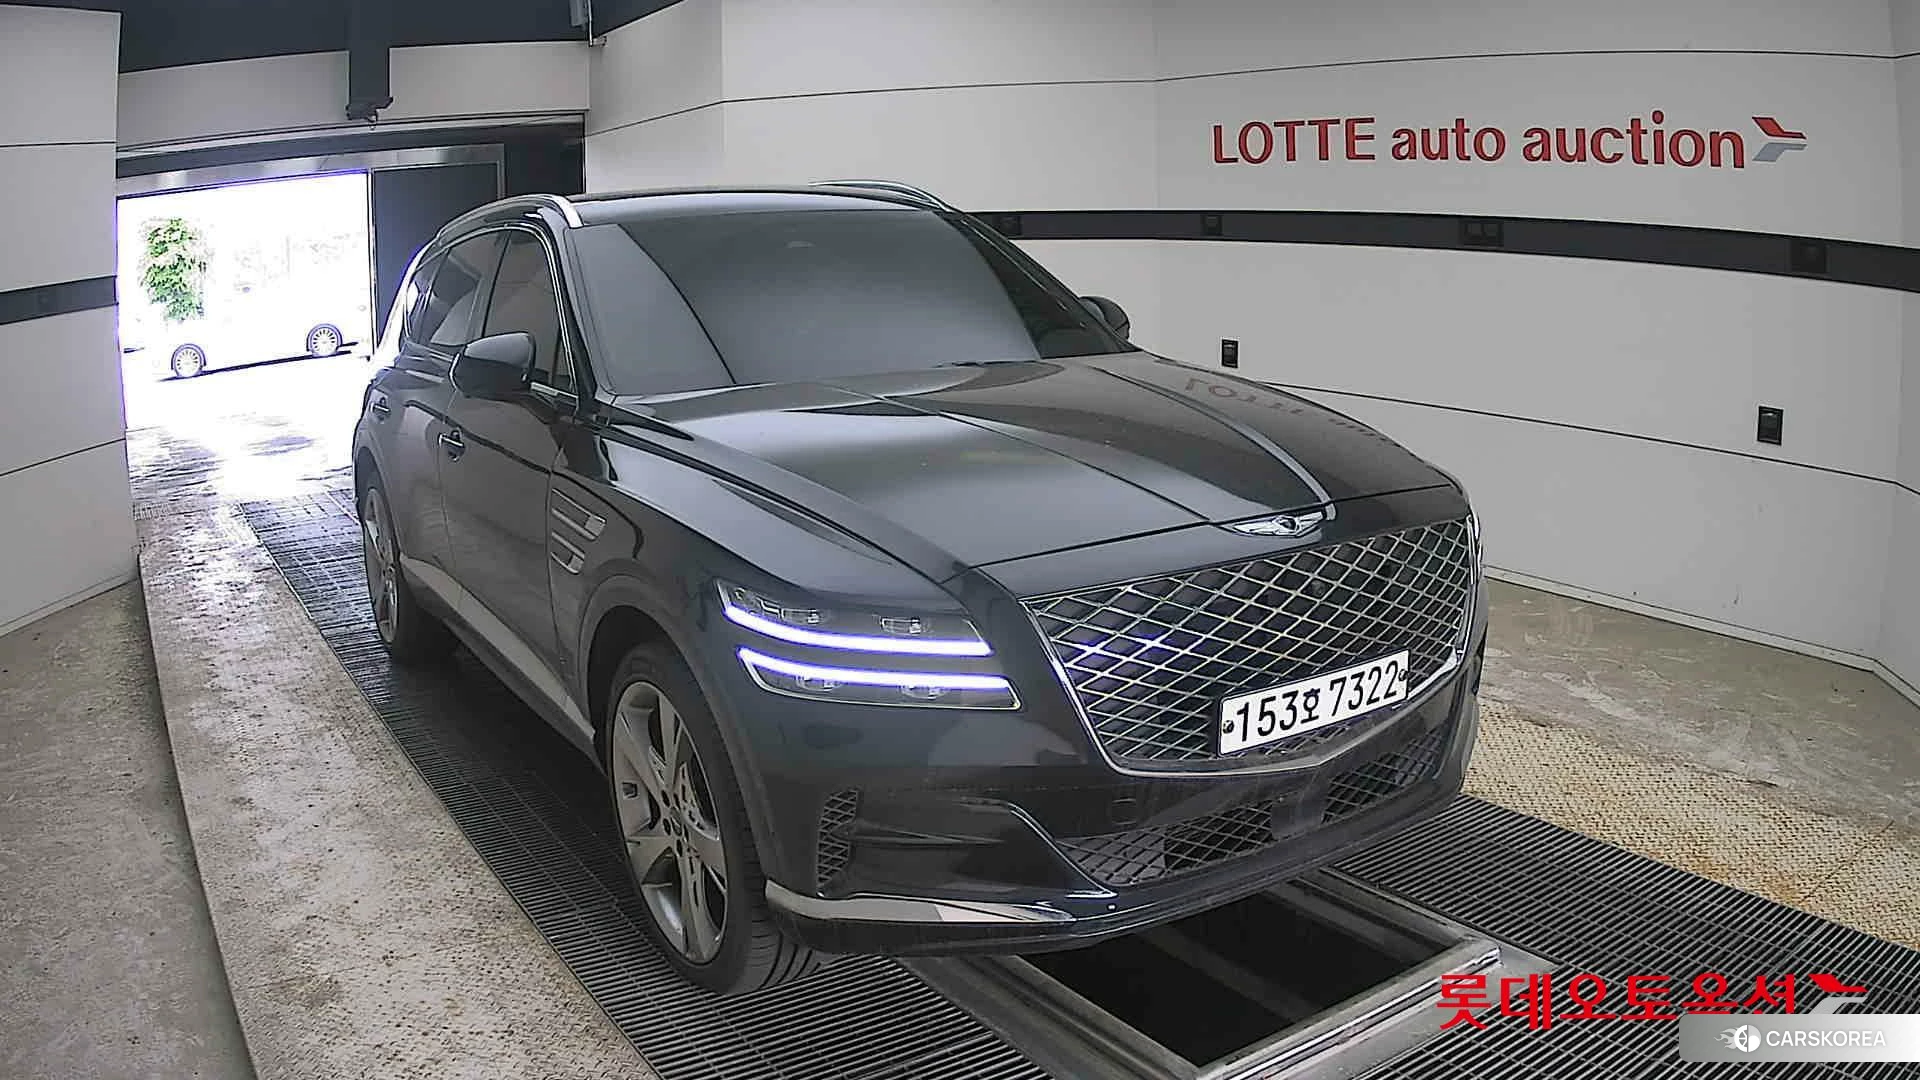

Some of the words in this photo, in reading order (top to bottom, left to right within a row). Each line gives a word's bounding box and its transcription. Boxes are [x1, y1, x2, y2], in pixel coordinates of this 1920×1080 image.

[1212, 117, 1376, 164] LOTTE
[1391, 118, 1507, 162] auto
[1522, 110, 1745, 168] auction
[1236, 688, 1321, 742] 153호
[1329, 660, 1399, 717] 7322
